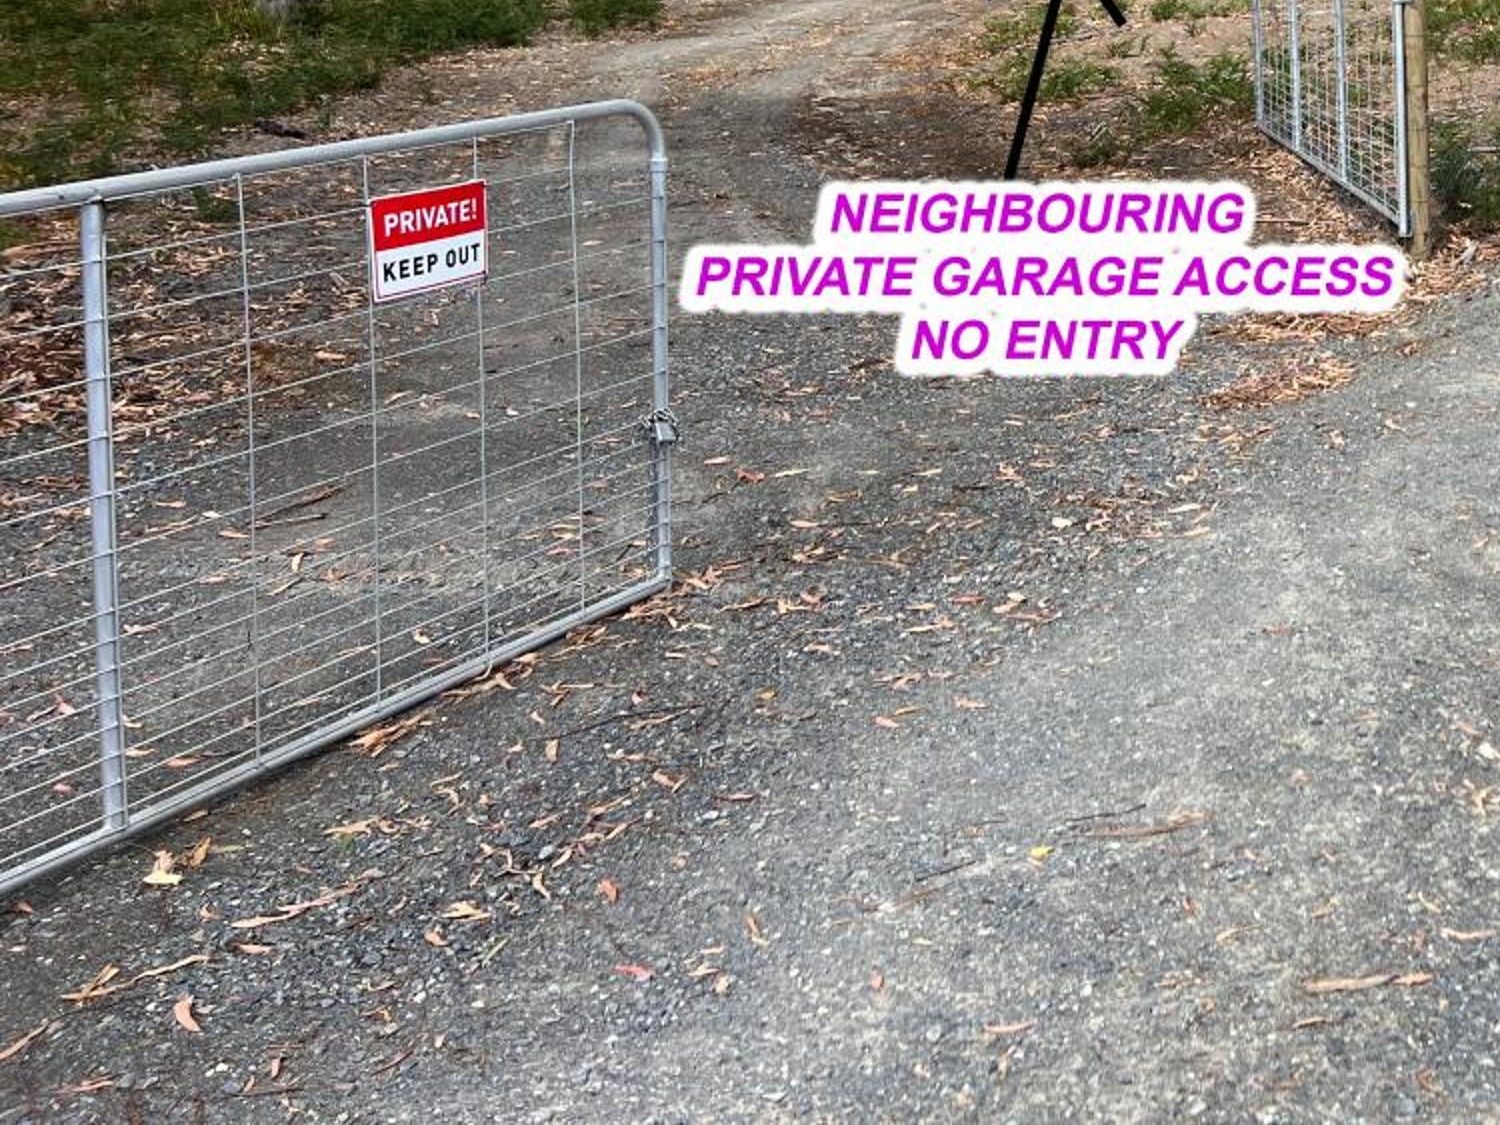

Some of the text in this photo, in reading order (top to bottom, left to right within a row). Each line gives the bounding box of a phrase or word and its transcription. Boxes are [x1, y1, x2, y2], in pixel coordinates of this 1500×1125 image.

[384, 198, 477, 237] PRIVATE!
[383, 243, 480, 283] KEEP OUT
